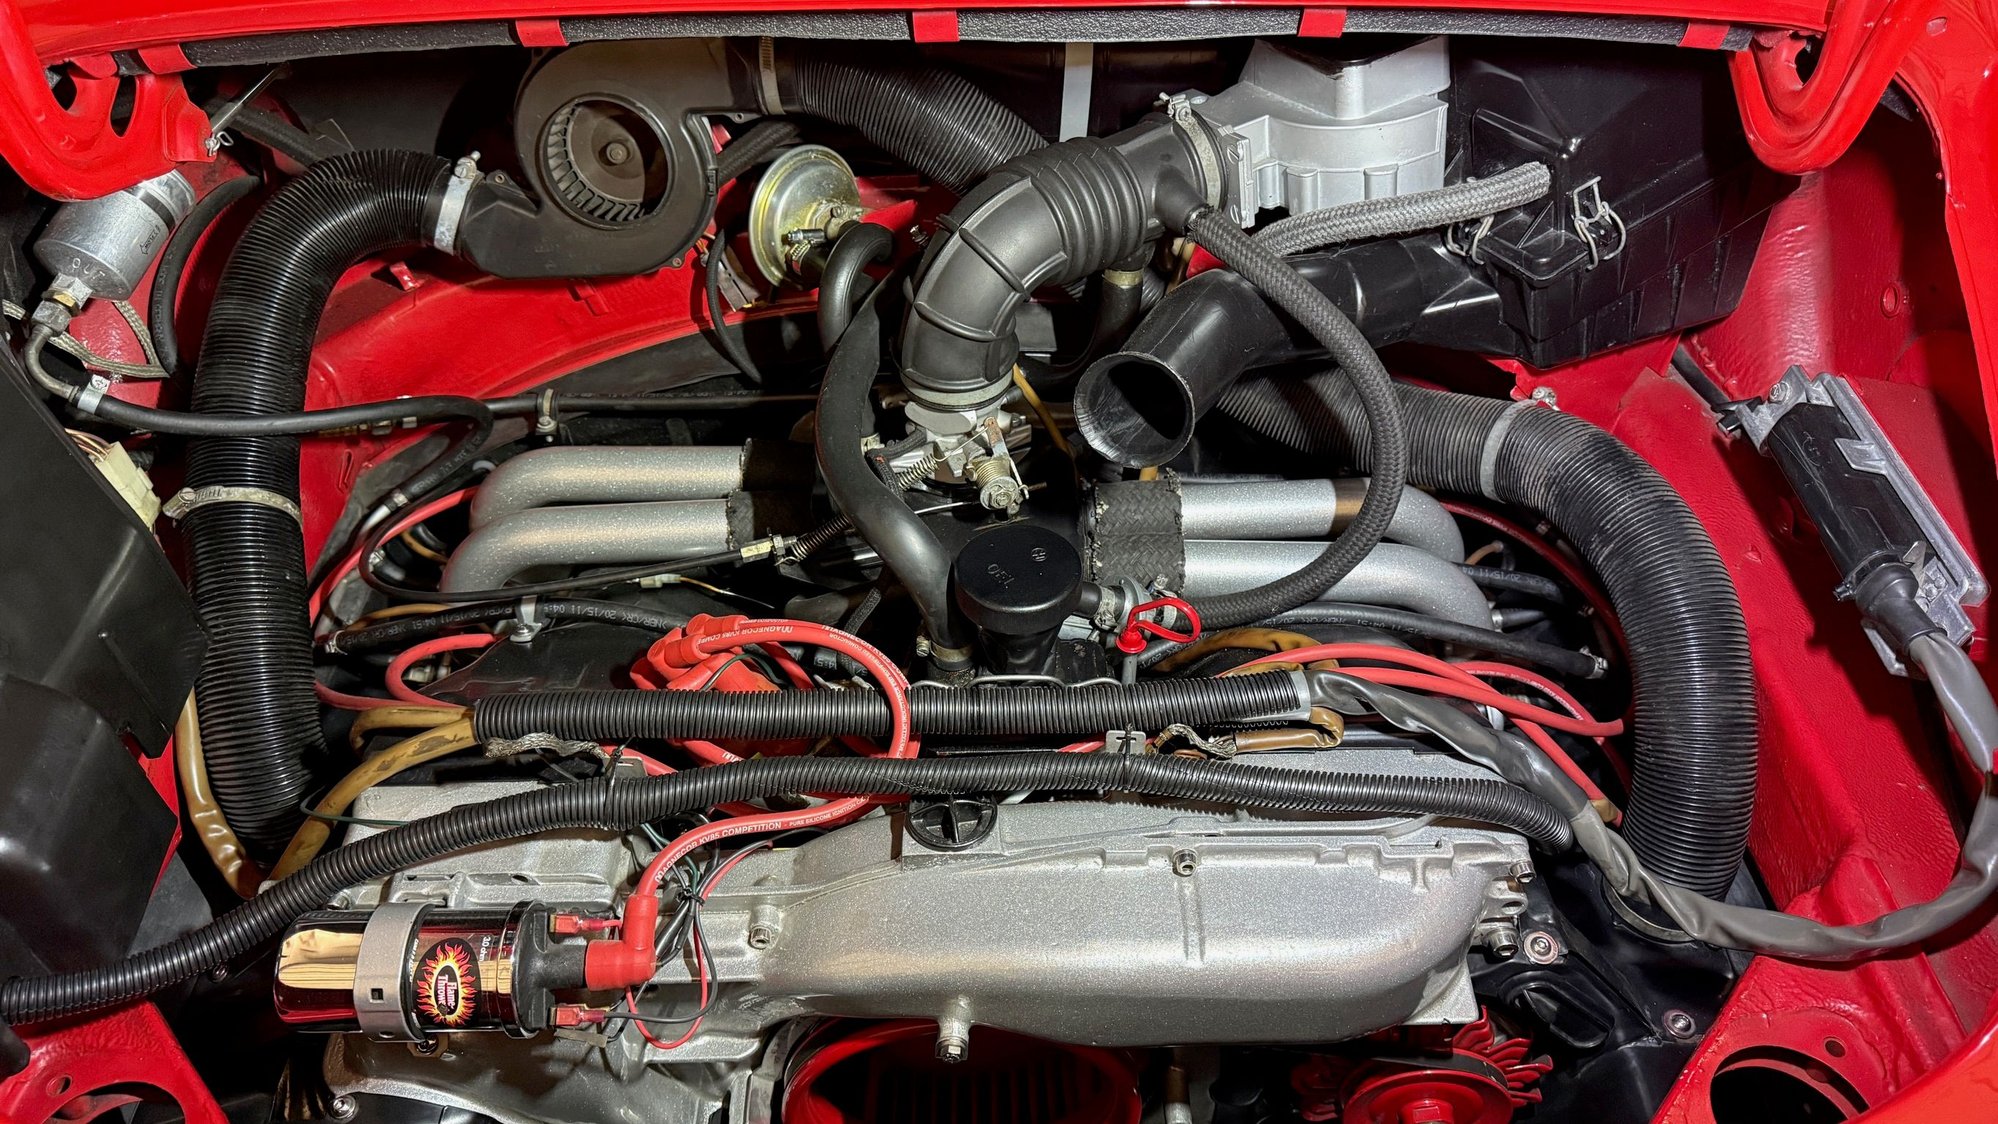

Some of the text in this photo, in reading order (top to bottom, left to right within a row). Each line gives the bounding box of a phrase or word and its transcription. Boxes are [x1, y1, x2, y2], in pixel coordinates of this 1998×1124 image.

[72, 257, 106, 281] OUT
[543, 603, 566, 614] 04:5
[571, 604, 617, 619] 20/15/11
[741, 626, 793, 635] MAGNECOR
[655, 841, 698, 883] MAGNECOR
[699, 832, 720, 845] KV85
[722, 822, 781, 836] COMPETITION
[806, 814, 831, 824] SILICONE
[857, 797, 868, 805] CA
[437, 974, 448, 1005] Throwe
